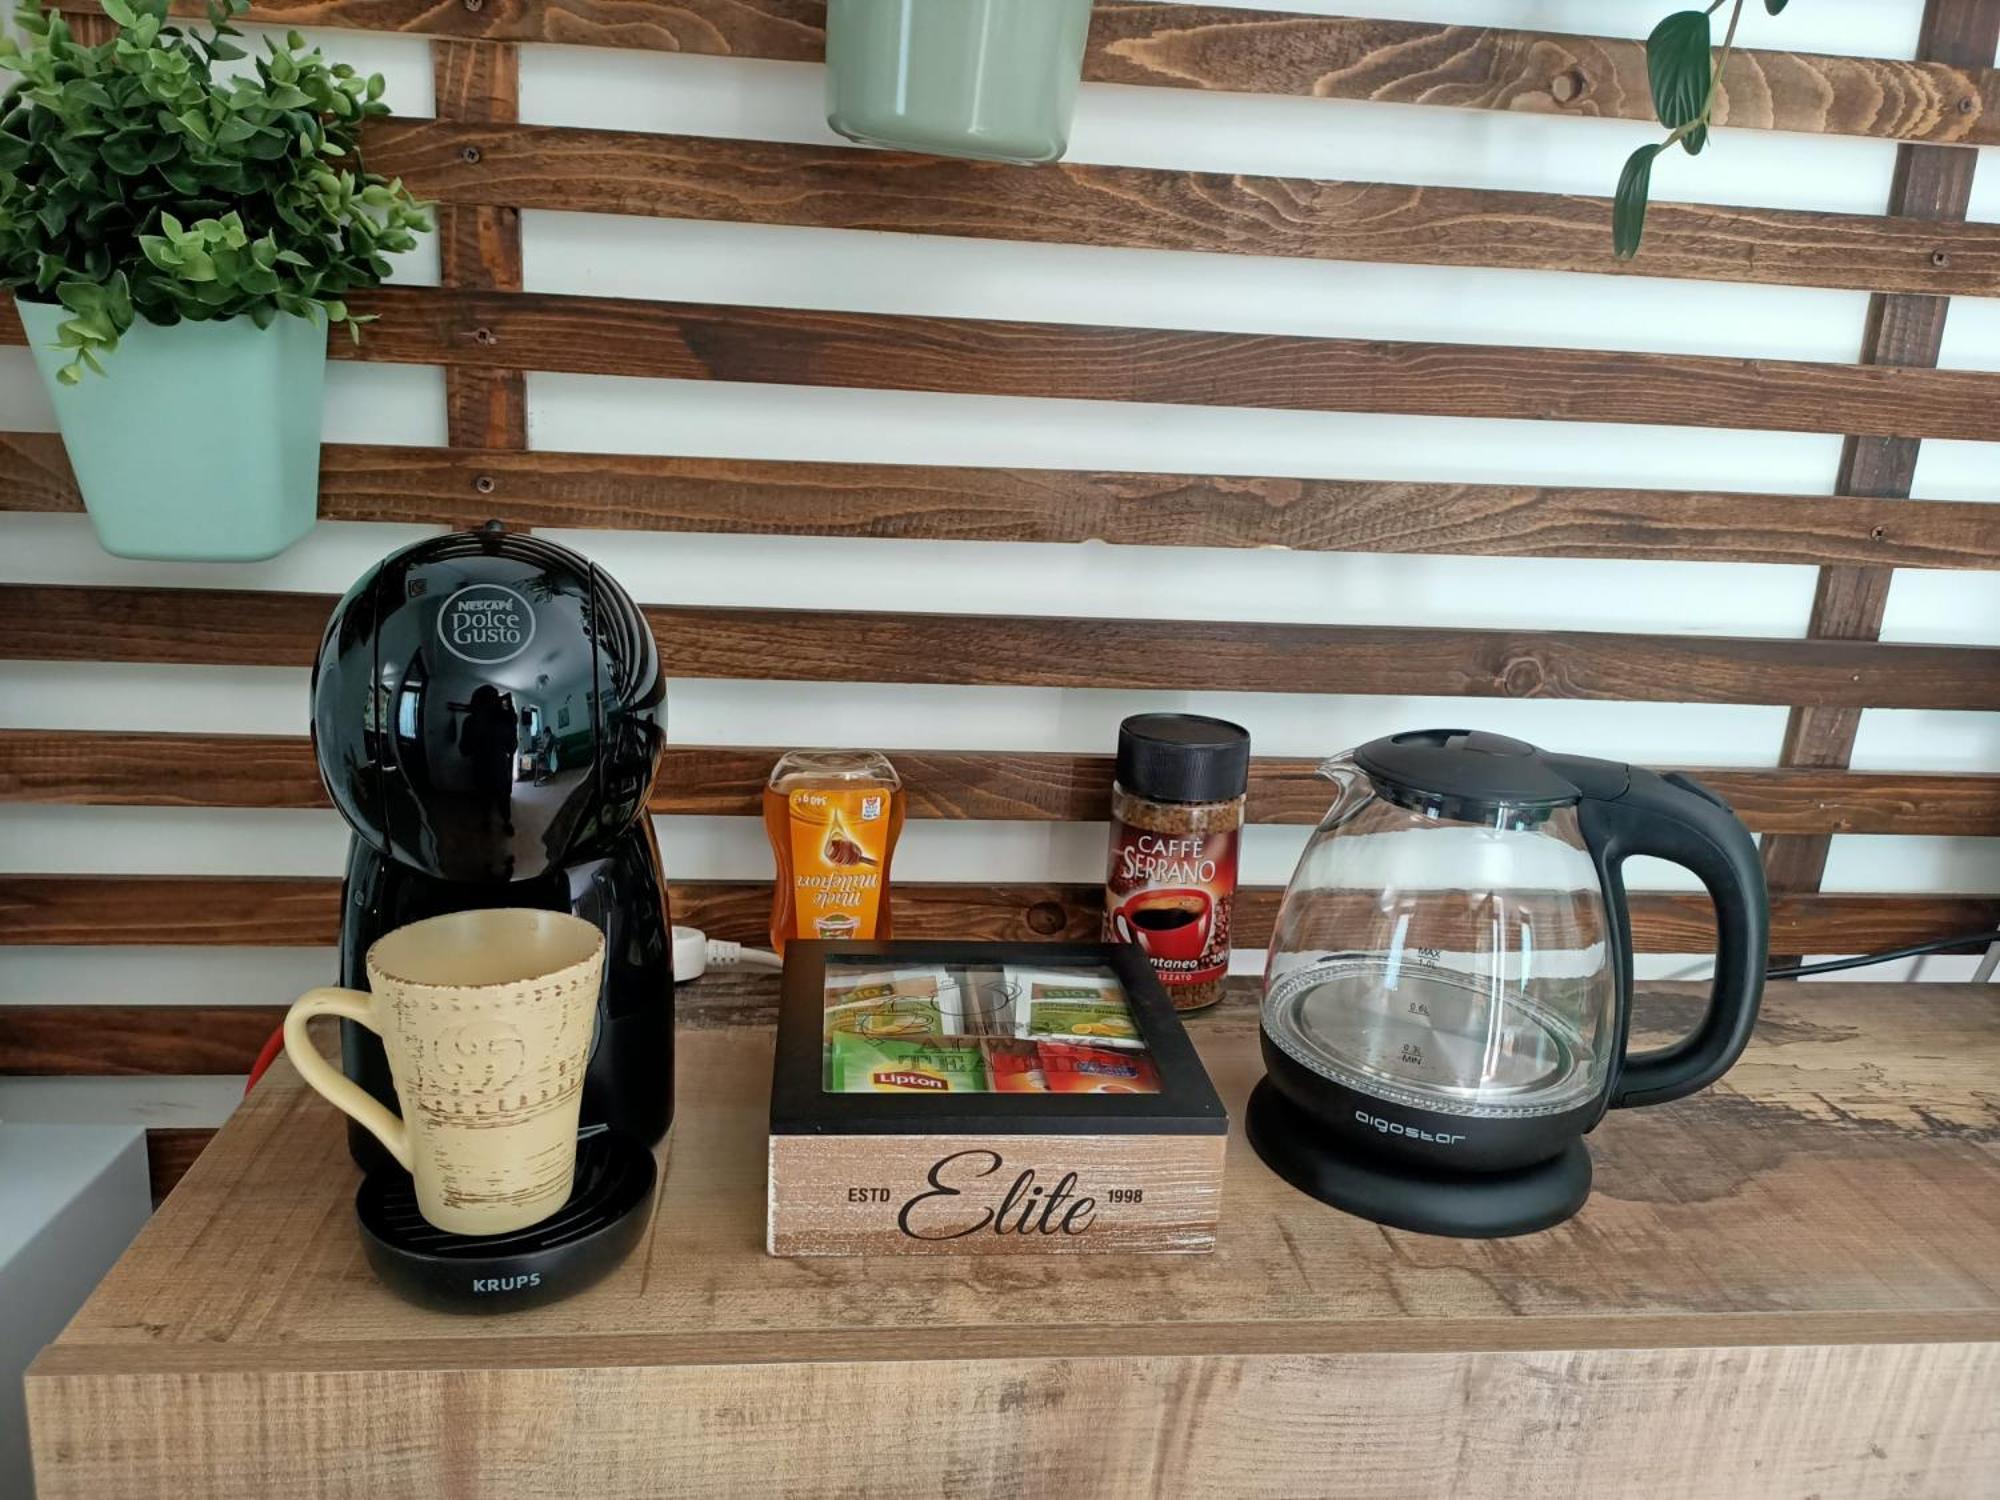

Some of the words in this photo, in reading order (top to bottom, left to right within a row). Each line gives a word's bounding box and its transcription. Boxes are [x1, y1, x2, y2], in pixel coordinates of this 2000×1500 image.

[458, 598, 513, 612] NESCAFÉ
[451, 610, 520, 629] Dolce
[453, 626, 521, 645] Gusto
[1121, 845, 1216, 883] SERRANO
[1418, 947, 1440, 959] MAX
[1149, 957, 1198, 969] ntaneo
[1158, 972, 1192, 981] IZZATO
[880, 1073, 942, 1088] Lipton
[1355, 1110, 1466, 1145] aigostar
[848, 1187, 891, 1202] ESTD
[897, 1149, 1096, 1241] Elite
[1107, 1188, 1143, 1203] 1998
[473, 1272, 541, 1292] KRUPS
